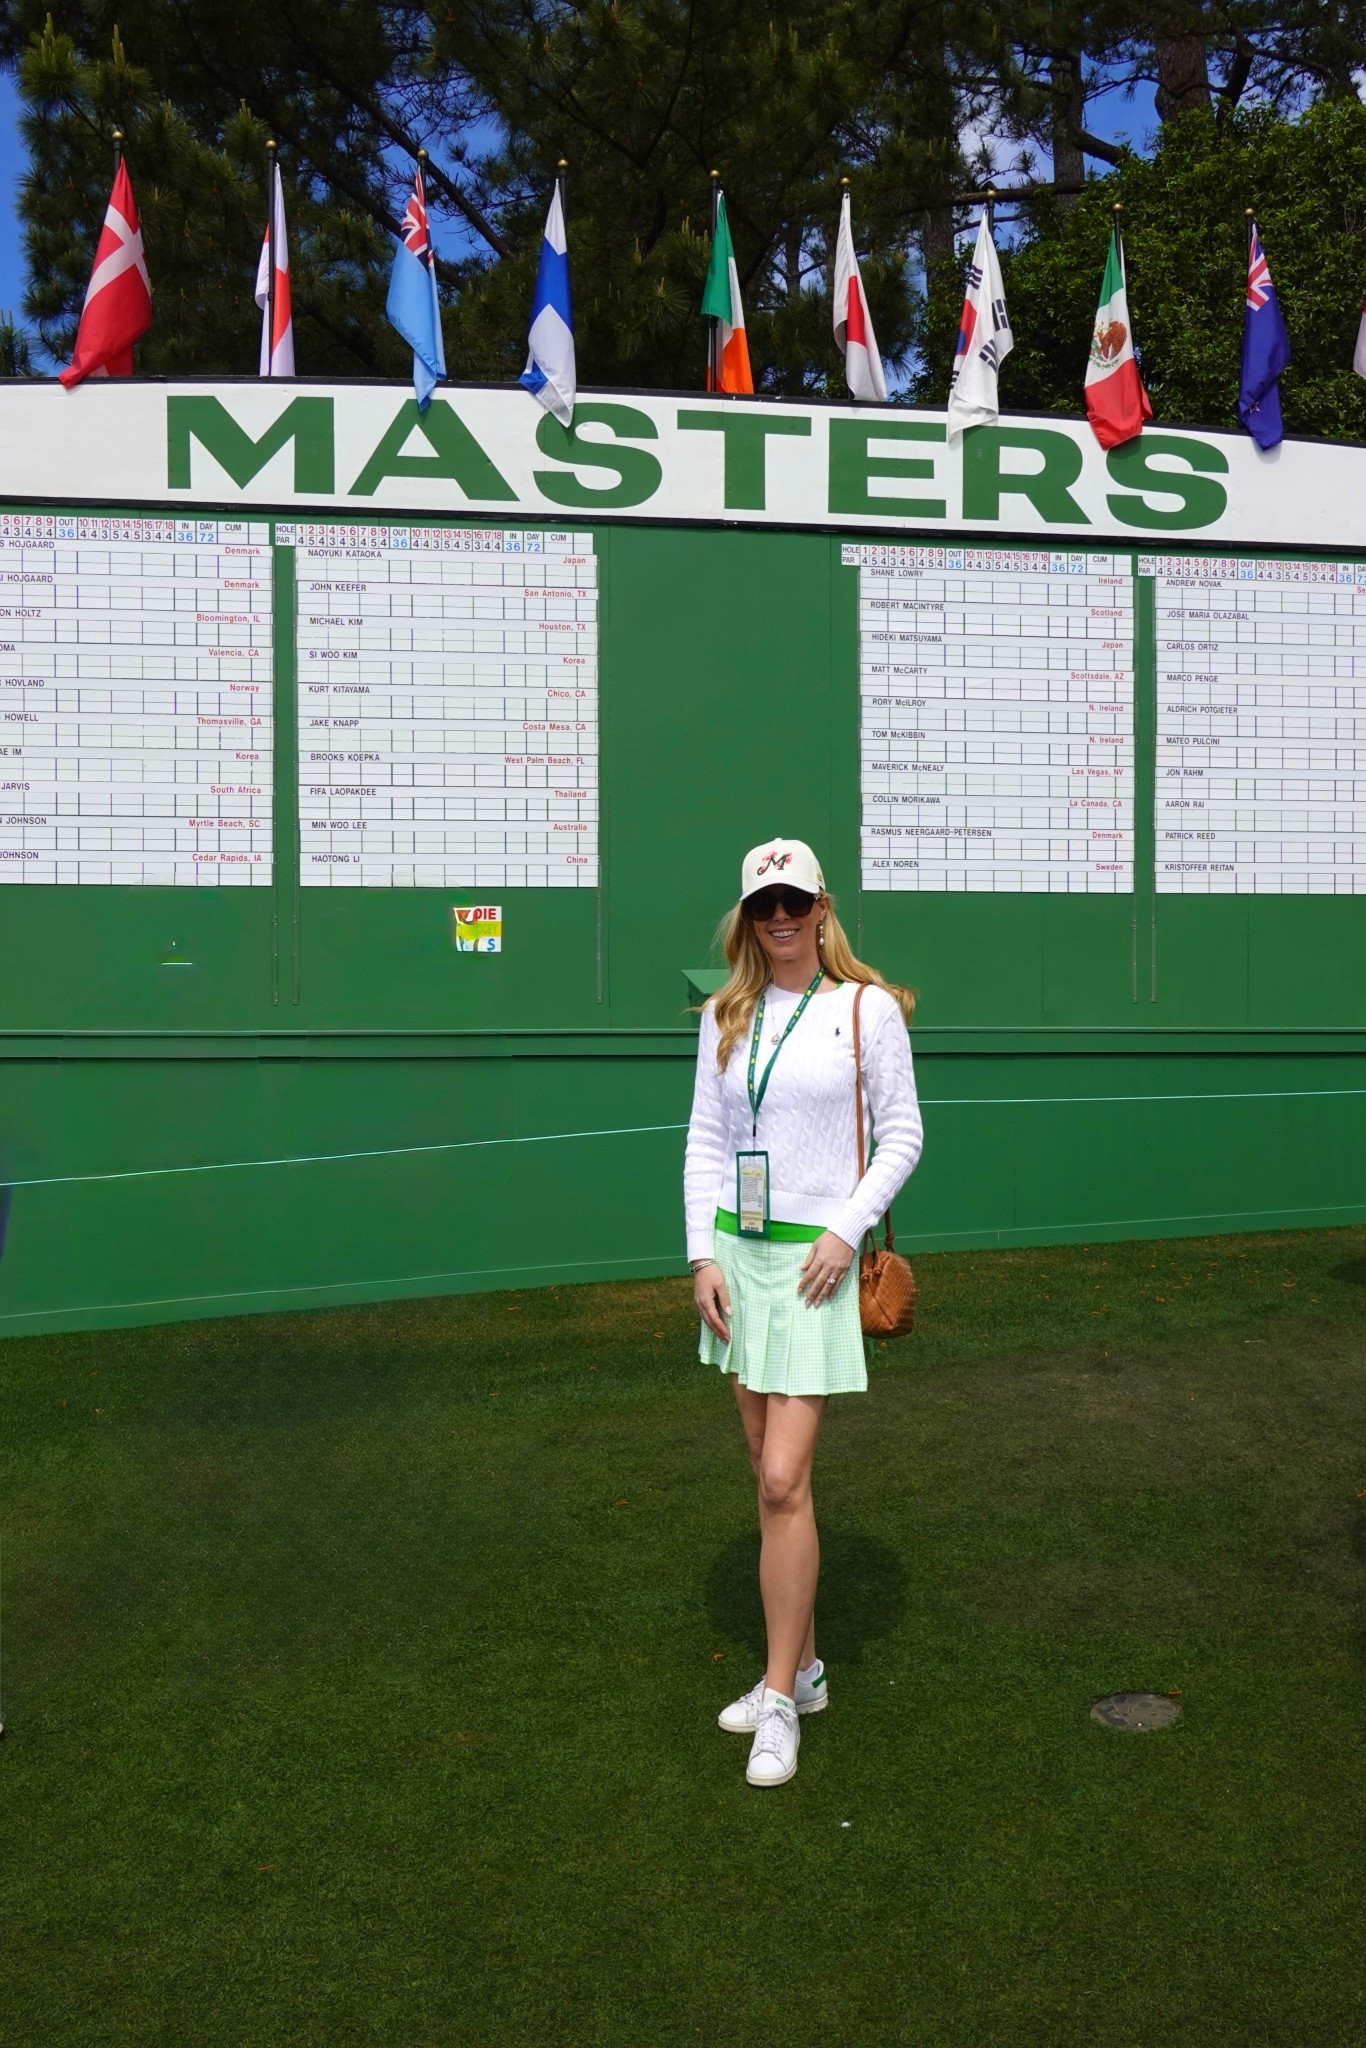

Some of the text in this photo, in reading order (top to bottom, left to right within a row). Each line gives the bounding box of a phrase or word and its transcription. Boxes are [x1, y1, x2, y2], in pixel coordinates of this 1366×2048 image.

[168, 397, 1228, 529] MASTERS
[59, 518, 74, 526] OUT
[199, 523, 213, 531] DAY
[224, 523, 241, 532] CUM
[276, 525, 295, 534] HOLE
[393, 528, 407, 536] OUT
[527, 533, 540, 541] DAY
[550, 533, 567, 542] CUM
[9, 540, 54, 548] HOJGAARD
[276, 536, 541, 552] PAR 36 36 72
[225, 547, 260, 556] Denmark
[308, 549, 382, 558] NAOYUKI KATAOKA
[842, 556, 855, 564] PAR
[948, 550, 961, 558] OUT
[1093, 555, 1107, 563] CUM
[563, 557, 586, 566] Japan
[1240, 560, 1253, 568] OUT
[7, 574, 53, 584] HOJGAARD
[224, 580, 259, 588] Denmark
[542, 590, 574, 599] Antonio,
[871, 601, 944, 612] ROBERT MACINTYRE
[15, 609, 41, 617] HOLTZ
[1213, 612, 1249, 620] OLAZABAL
[197, 614, 250, 623] Bloomington,
[310, 617, 345, 625] MICHAEL
[539, 623, 573, 631] Houston,
[900, 634, 942, 644] MATSUYAMA
[1102, 641, 1123, 650] Japan
[209, 649, 245, 658] Valencia,
[1071, 672, 1112, 681] Scottsdale,
[6, 679, 44, 687] HOVLAND
[230, 684, 259, 692] Norway
[548, 690, 572, 698] Chico,
[896, 699, 926, 707] McILROY
[1089, 704, 1095, 712] N.
[1200, 706, 1238, 714] POTGIETER
[5, 713, 38, 721] HOWELL
[197, 717, 247, 726] Thomasville,
[550, 723, 572, 732] Mesa,
[1090, 736, 1096, 744] N.
[311, 753, 344, 761] BROOKS
[548, 757, 573, 766] Beach,
[872, 763, 908, 771] MAVERICK
[1088, 768, 1111, 777] Vegas,
[238, 786, 261, 794] Africa
[873, 795, 898, 803] COLLIN
[1081, 800, 1110, 808] Canada,
[189, 819, 214, 828] Myrtle
[218, 820, 245, 828] Beach,
[330, 821, 349, 829] WOO
[220, 854, 250, 864] Rapids,
[757, 852, 792, 875] M
